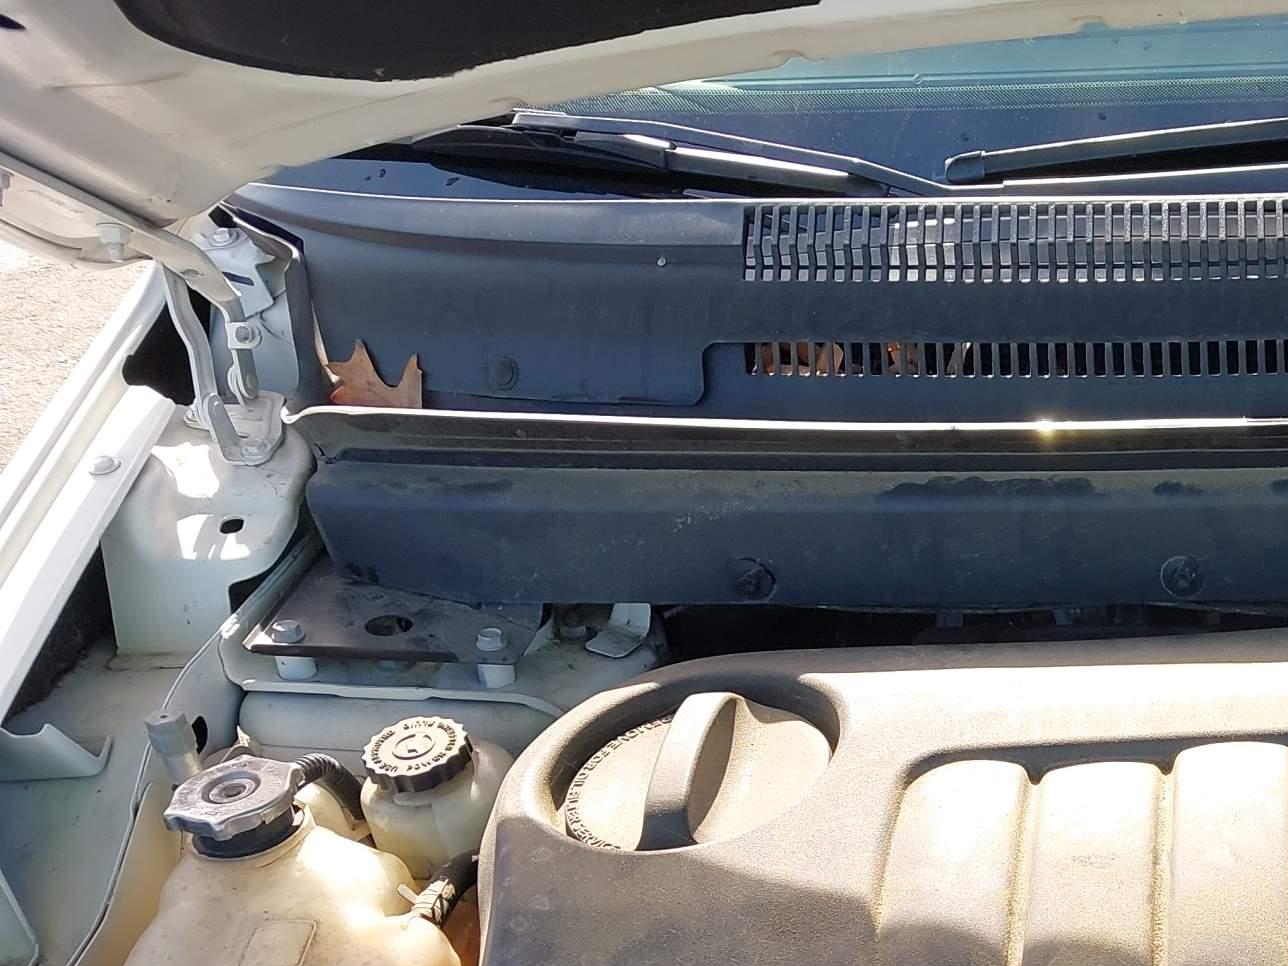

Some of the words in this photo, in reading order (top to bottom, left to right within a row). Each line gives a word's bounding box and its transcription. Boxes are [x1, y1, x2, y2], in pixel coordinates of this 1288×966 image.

[583, 746, 610, 772] FOR
[570, 771, 589, 790] OIL
[567, 790, 582, 825] FILTER
